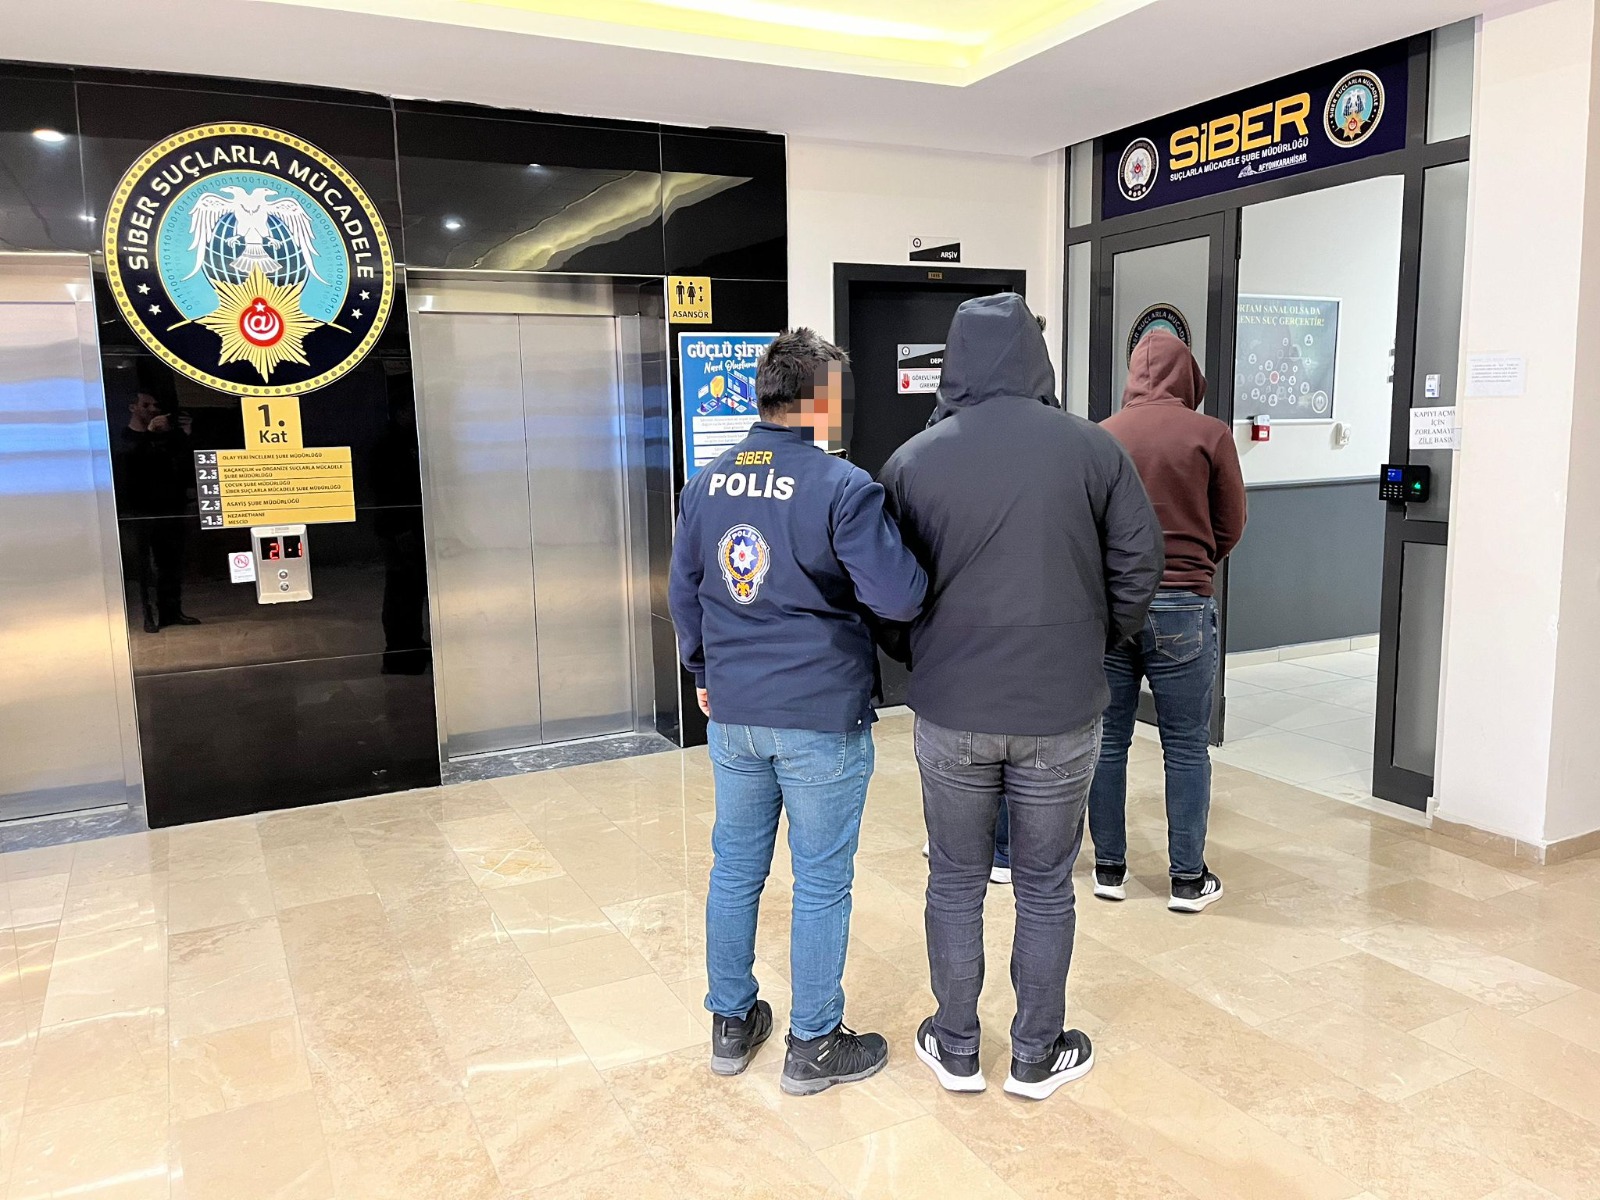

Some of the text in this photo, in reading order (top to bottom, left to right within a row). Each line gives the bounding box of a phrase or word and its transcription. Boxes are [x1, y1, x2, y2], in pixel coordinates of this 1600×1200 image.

[1169, 137, 1309, 182] SUÇLARLA MÜCADELE ŞUBE MÜDÜRLÜĞÜ
[1258, 153, 1307, 172] AFYONKARAHİSAR
[123, 145, 374, 279] SİBER SUÇLARLA MÜCADELE
[940, 251, 958, 260] ARŞİV
[672, 309, 709, 319] ASANSÖR
[1238, 304, 1321, 315] RTAM SANAL OLSA DA
[1262, 316, 1278, 326] SUÇ
[687, 341, 732, 360] GÜÇLÜ
[257, 404, 286, 427] 1.
[259, 430, 288, 444] Kat
[708, 468, 795, 500] POLİS
